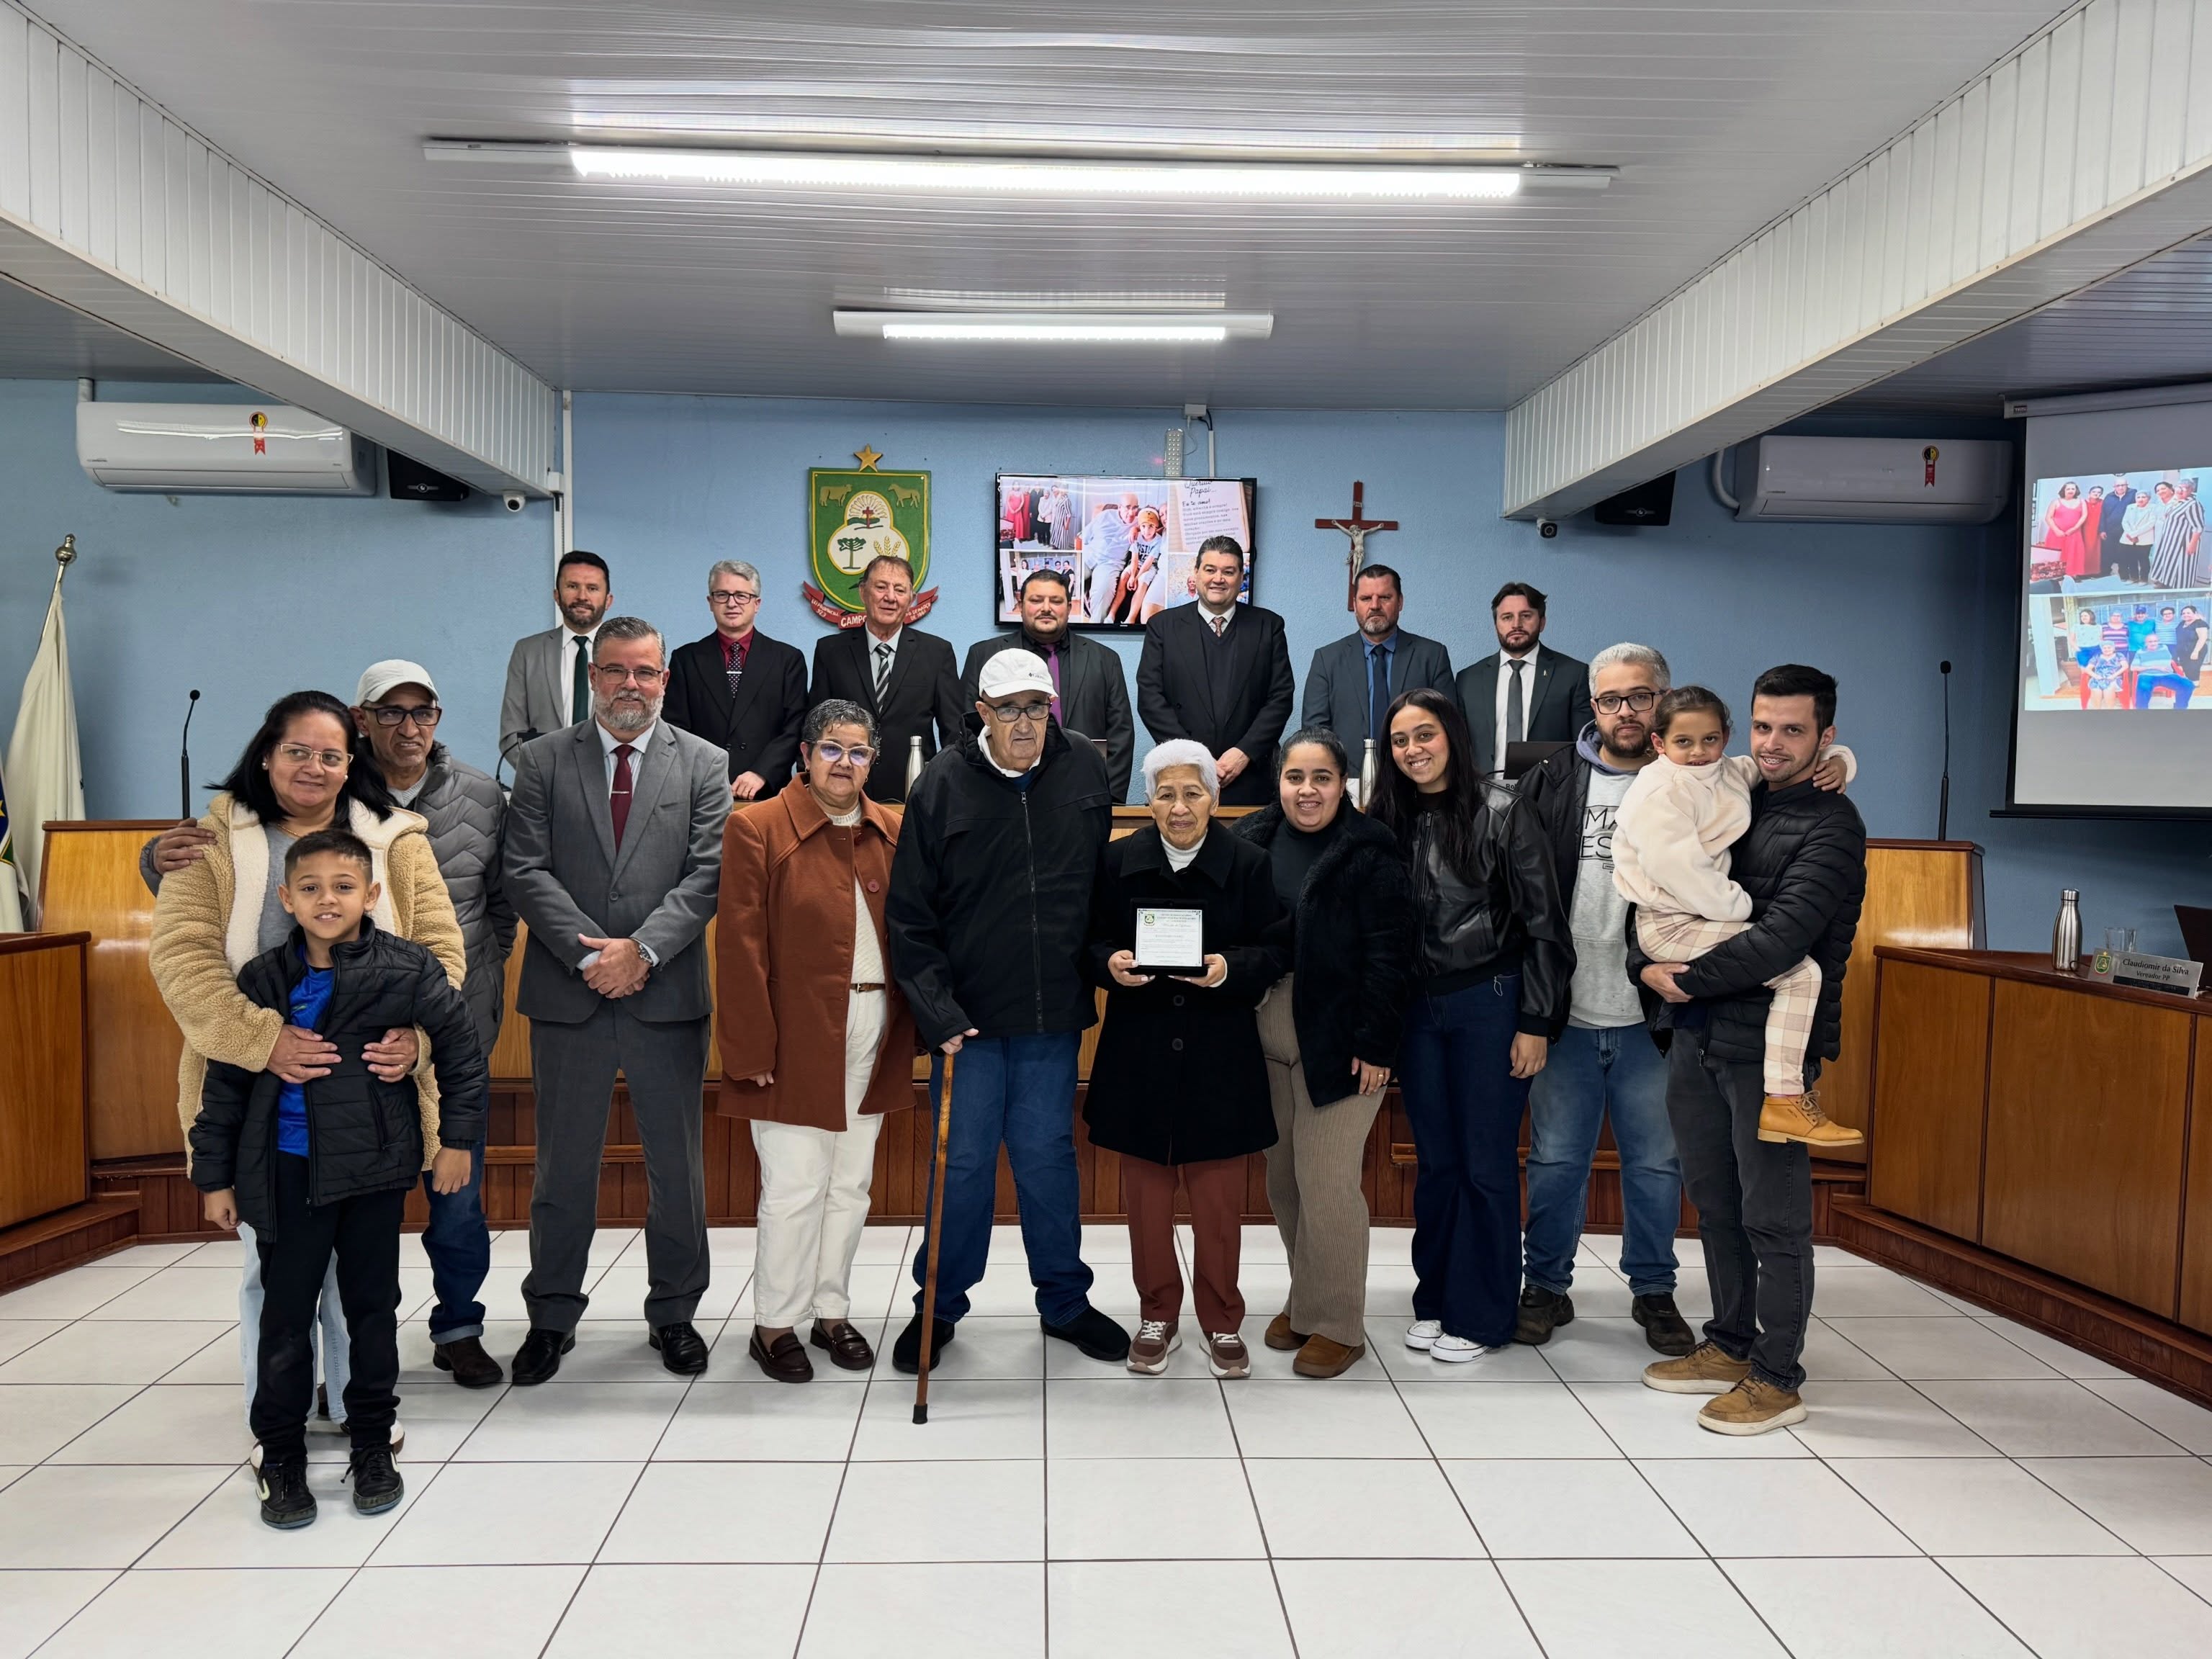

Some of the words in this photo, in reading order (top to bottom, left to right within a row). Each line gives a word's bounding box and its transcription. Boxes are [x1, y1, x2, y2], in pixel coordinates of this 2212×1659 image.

[2123, 958, 2160, 971] Claudiomir
[2172, 966, 2190, 975] Silva
[2136, 971, 2161, 980] Vereador
